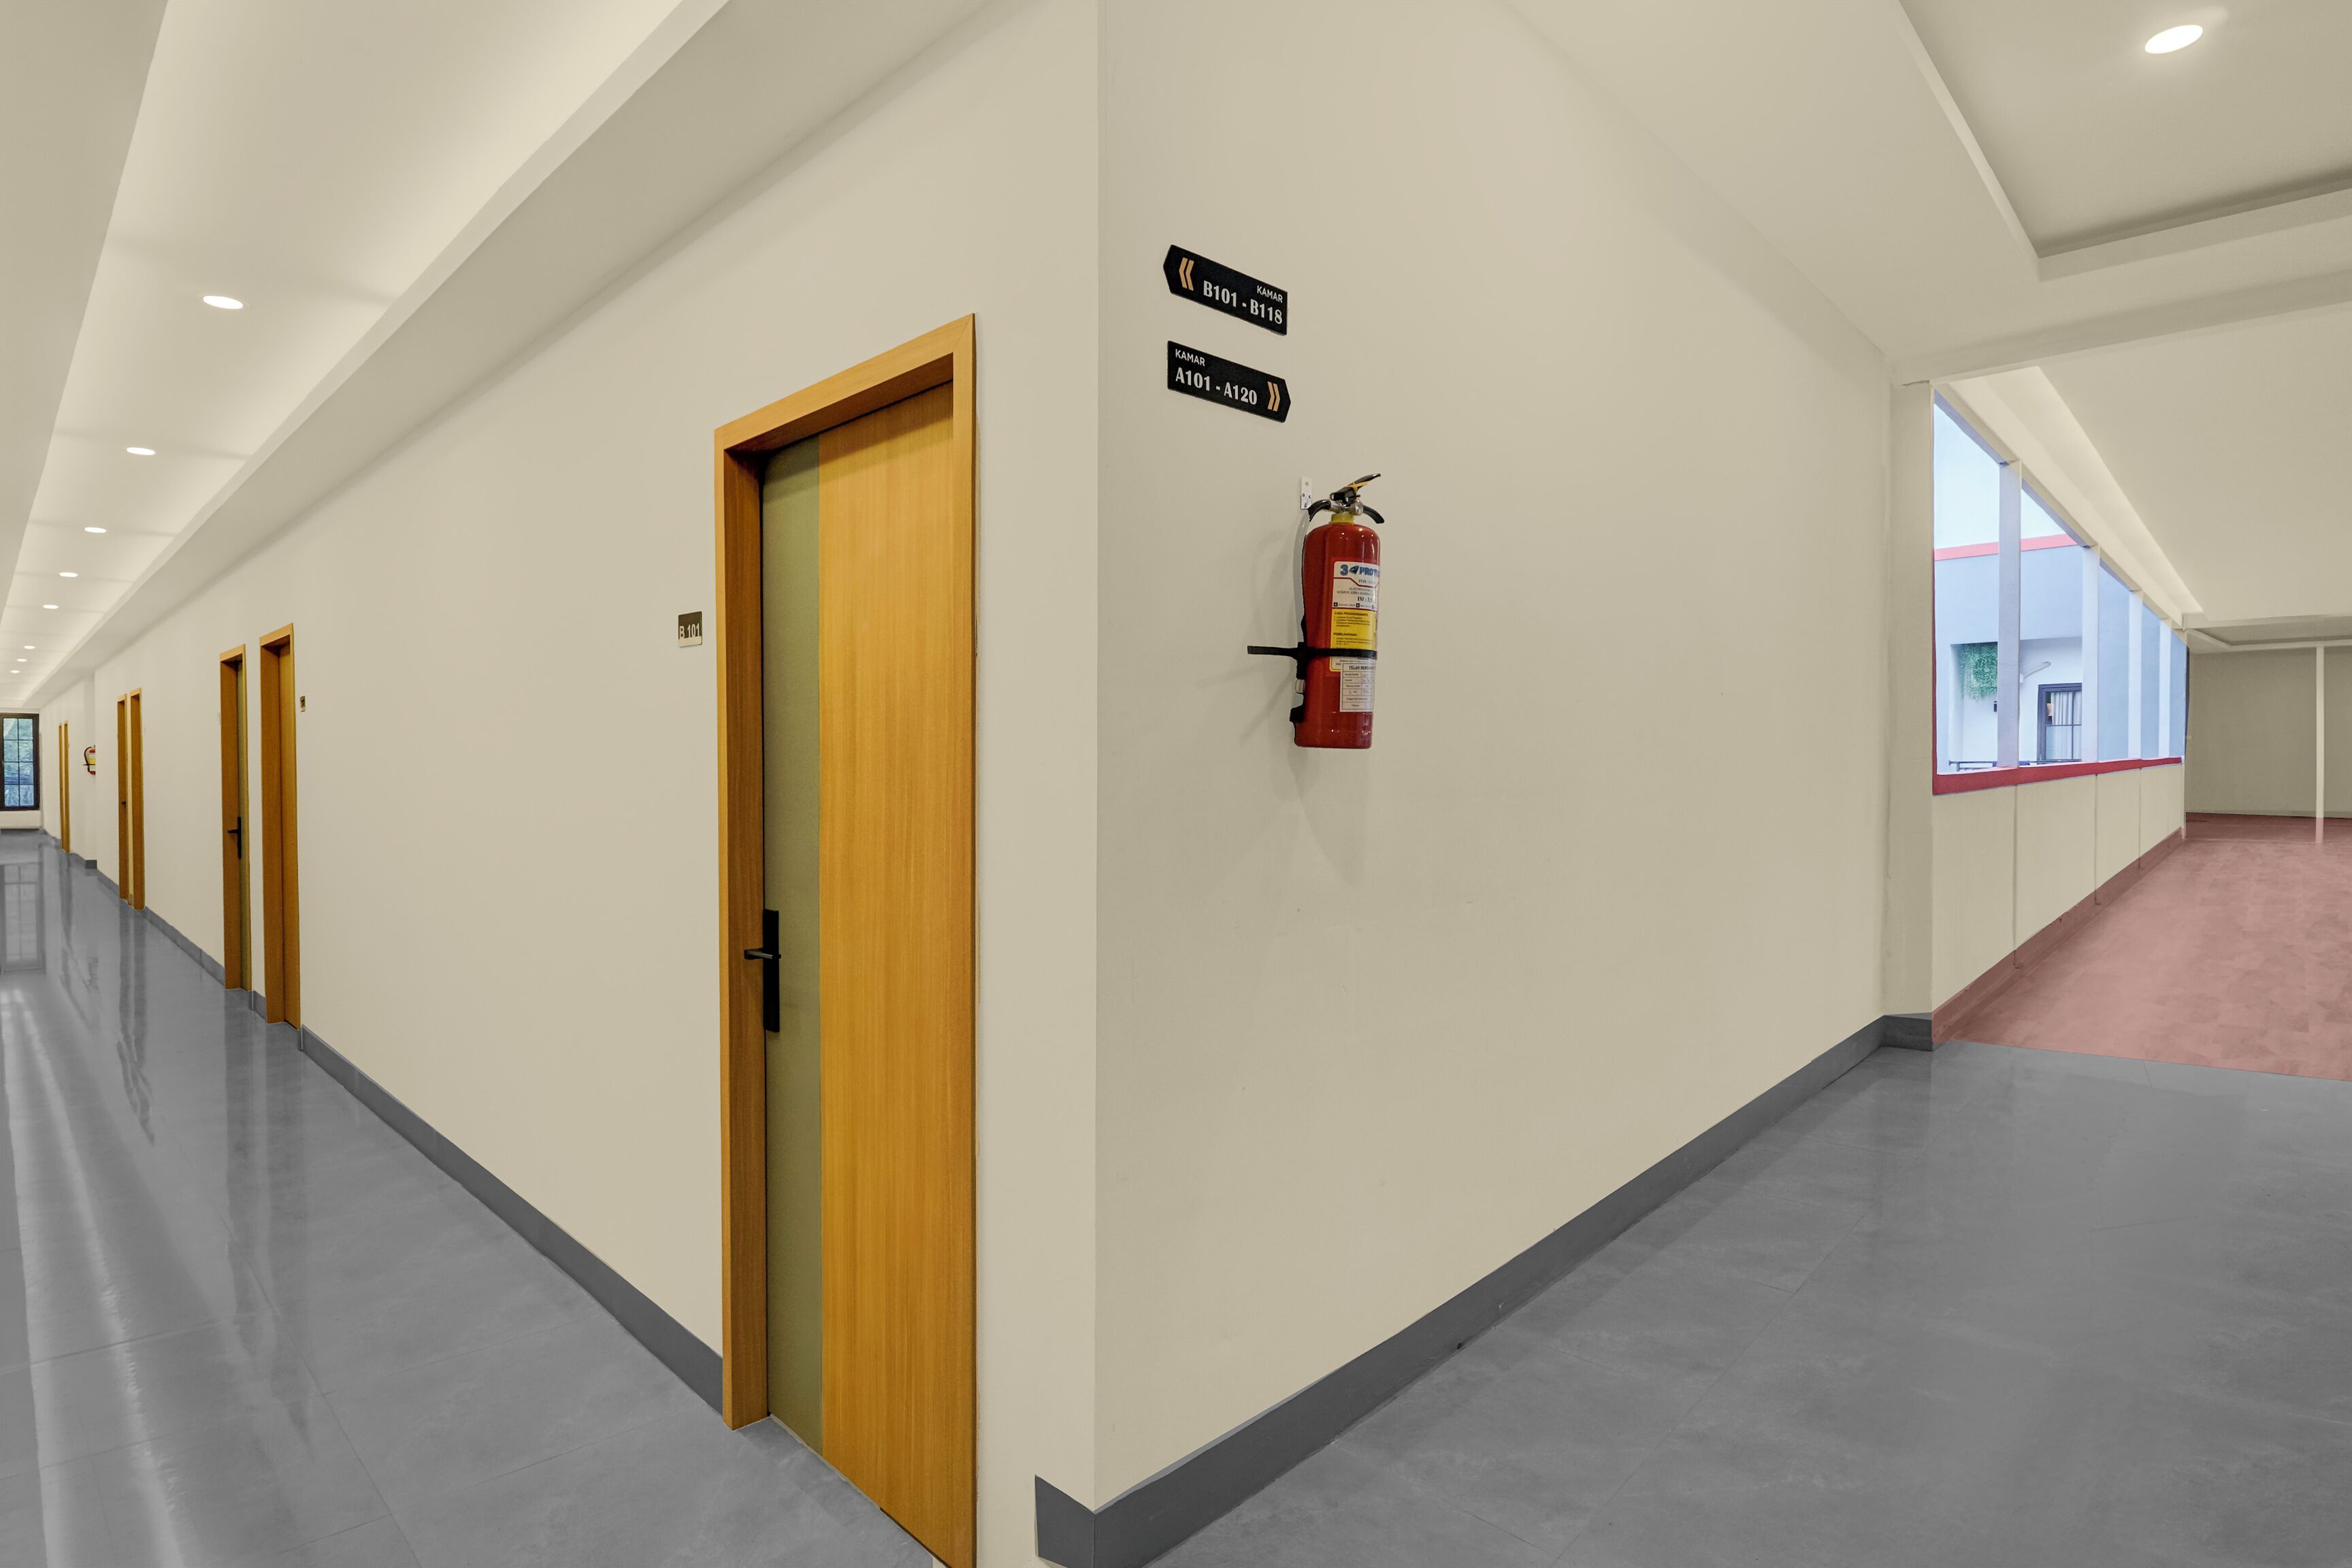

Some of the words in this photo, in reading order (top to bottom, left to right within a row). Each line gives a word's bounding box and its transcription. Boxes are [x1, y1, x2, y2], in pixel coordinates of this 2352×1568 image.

[1203, 280, 1237, 308] B101
[1250, 299, 1283, 325] B118
[1257, 285, 1283, 304] KAMAR
[1175, 348, 1205, 367] KAMAR
[1175, 367, 1210, 391] A101
[1224, 382, 1258, 405] A120
[1340, 564, 1348, 576] 3
[679, 625, 685, 639] B
[687, 622, 700, 638] 101
